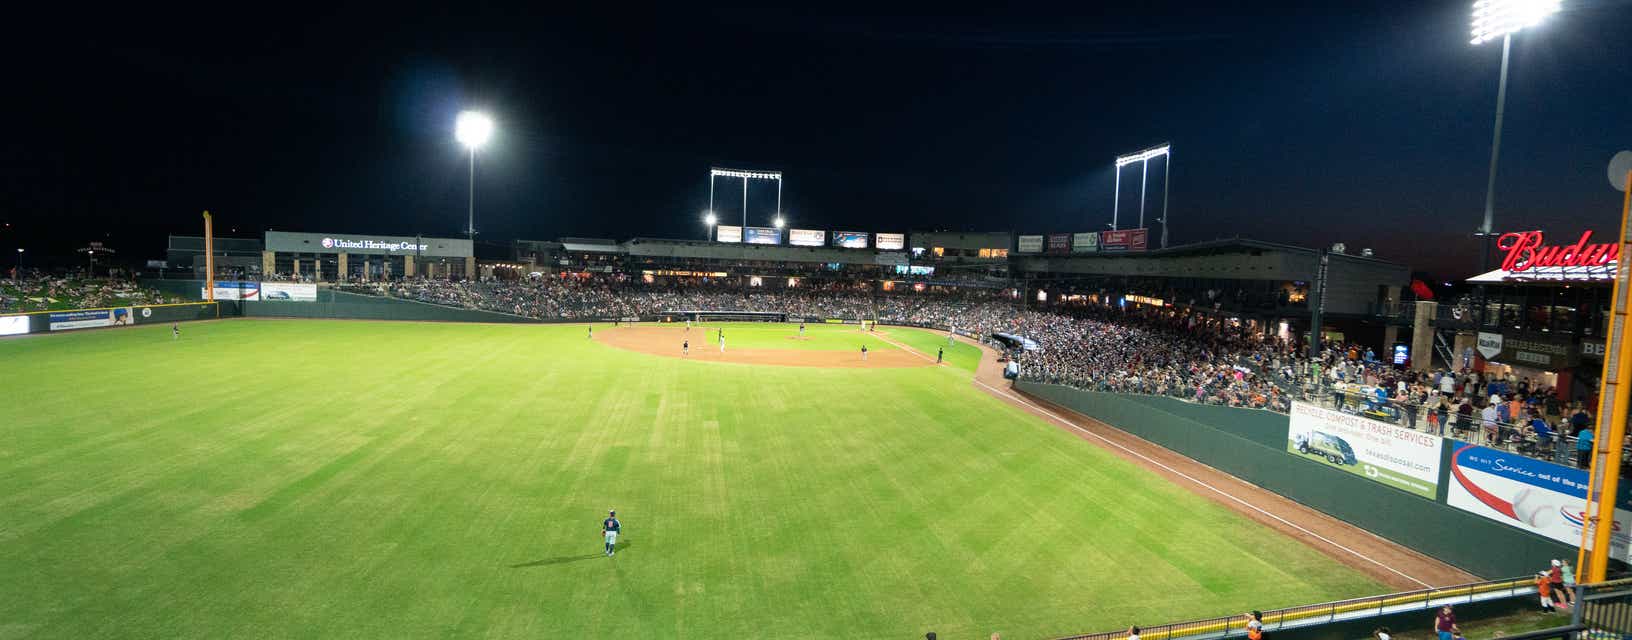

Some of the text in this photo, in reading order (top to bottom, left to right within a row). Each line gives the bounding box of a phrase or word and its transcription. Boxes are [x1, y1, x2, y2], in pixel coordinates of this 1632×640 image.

[334, 239, 428, 252] United Heritage Cener
[1326, 412, 1359, 428] COMPOST
[1360, 419, 1366, 430] &
[1367, 421, 1393, 437] TRASH
[1394, 428, 1434, 448] SERVICES
[1491, 458, 1536, 477] Service
[1538, 473, 1551, 481] out
[1552, 475, 1561, 483] of
[1562, 478, 1575, 487] the
